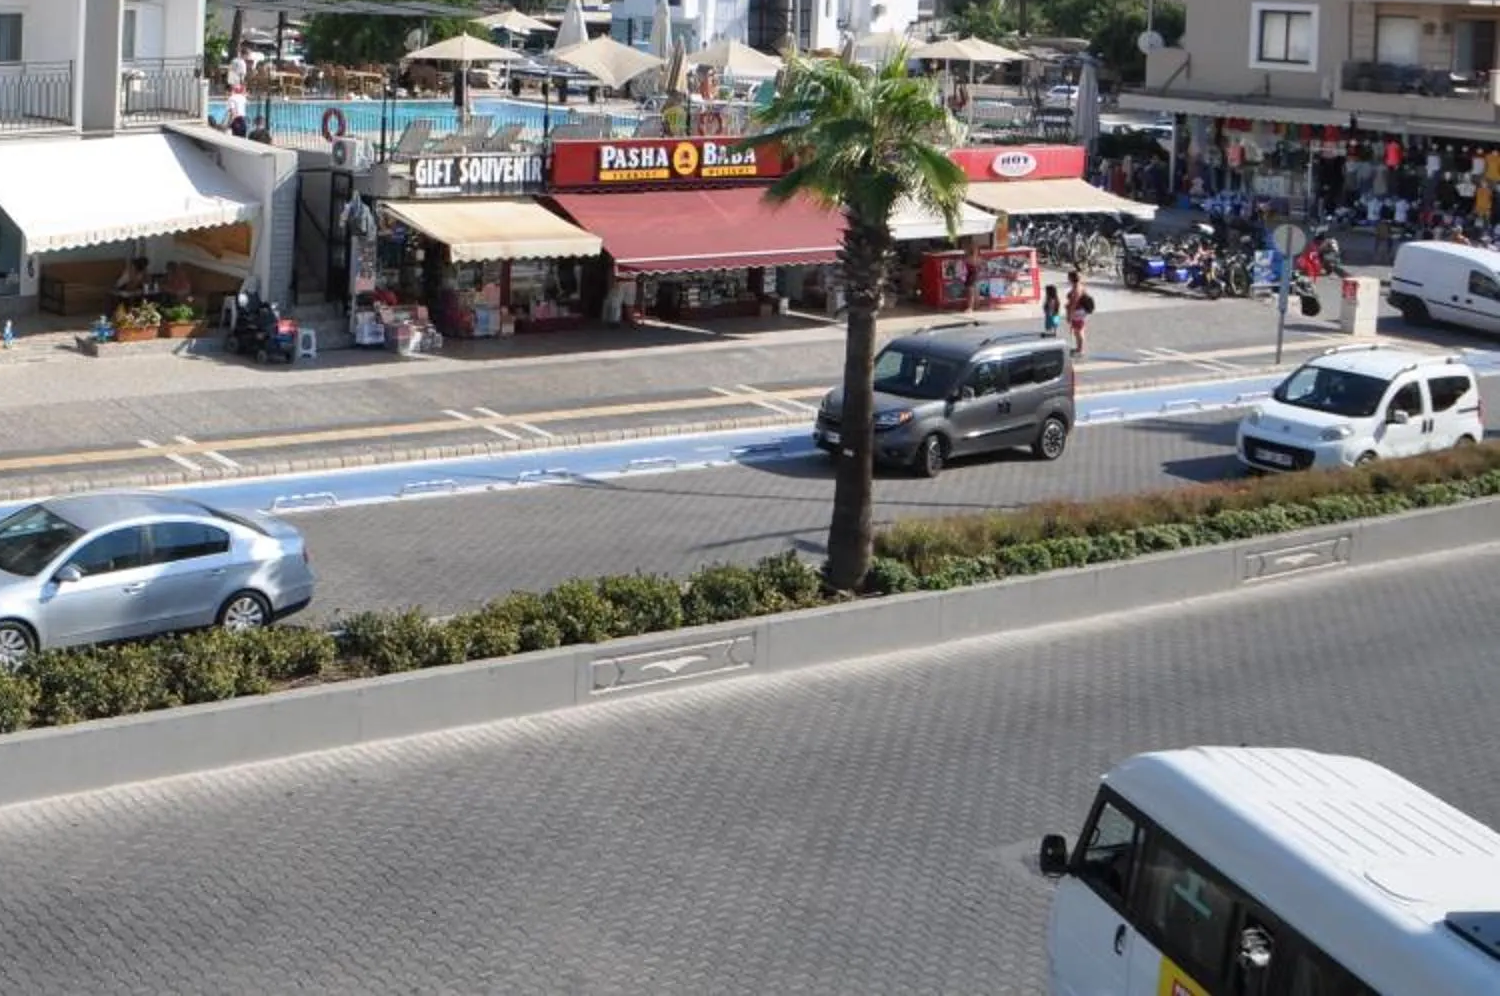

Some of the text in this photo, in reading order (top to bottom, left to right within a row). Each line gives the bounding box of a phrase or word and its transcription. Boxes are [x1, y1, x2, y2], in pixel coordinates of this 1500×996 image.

[601, 145, 669, 169] PASHA
[415, 156, 542, 185] GIFT SOUVENIR
